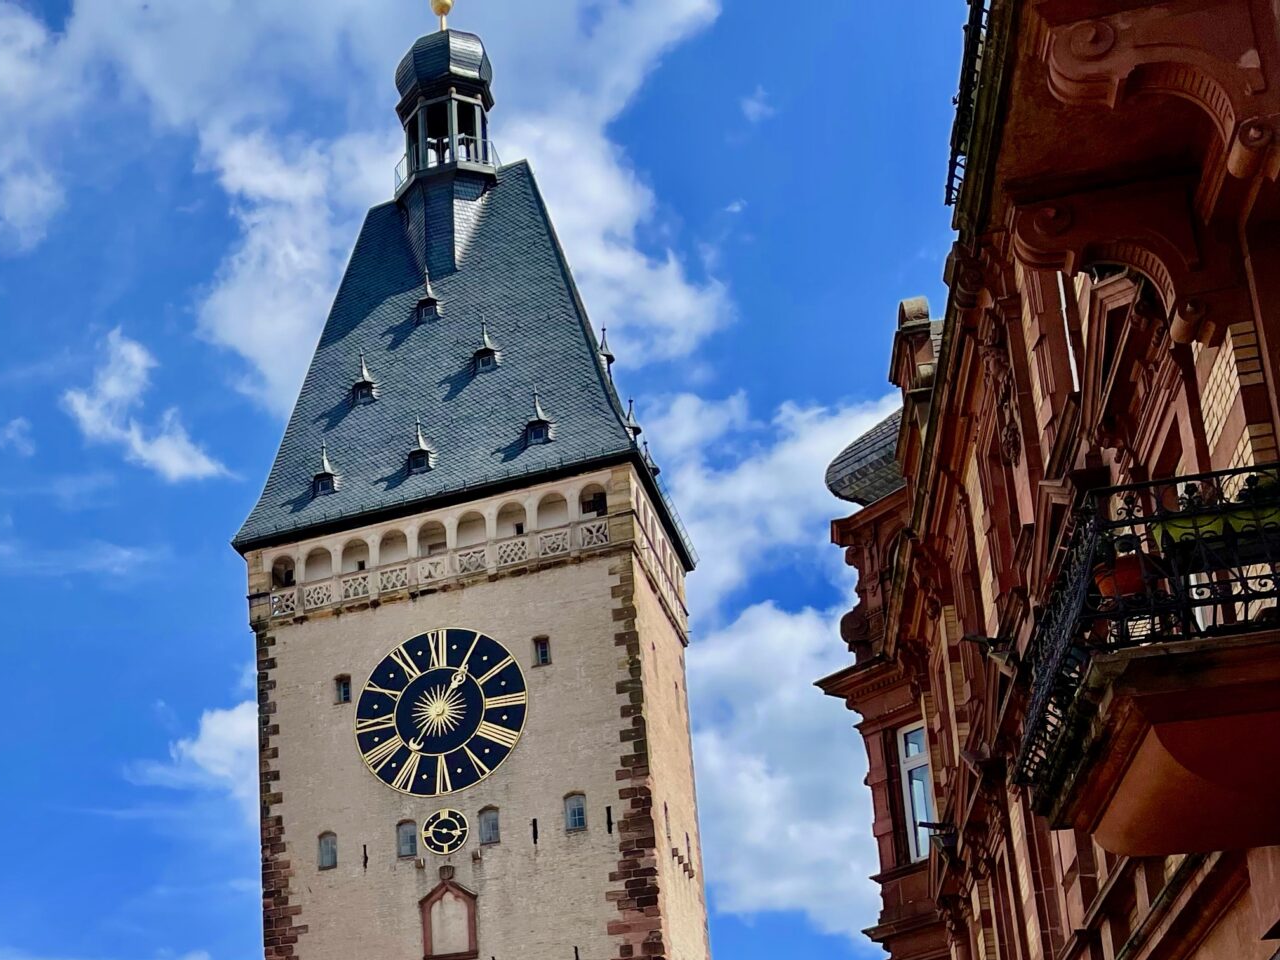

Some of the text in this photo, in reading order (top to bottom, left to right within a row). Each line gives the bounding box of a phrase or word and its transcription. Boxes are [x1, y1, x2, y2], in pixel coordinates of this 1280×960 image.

[389, 645, 422, 682] XI
[427, 629, 447, 669] XII
[477, 655, 515, 685] II
[364, 680, 402, 701] X
[485, 691, 526, 709] III
[356, 713, 395, 734] IX
[476, 720, 519, 748] IIII
[364, 734, 404, 773] VIII
[463, 744, 491, 779] V
[391, 752, 421, 792] VII
[436, 754, 452, 794] VI
